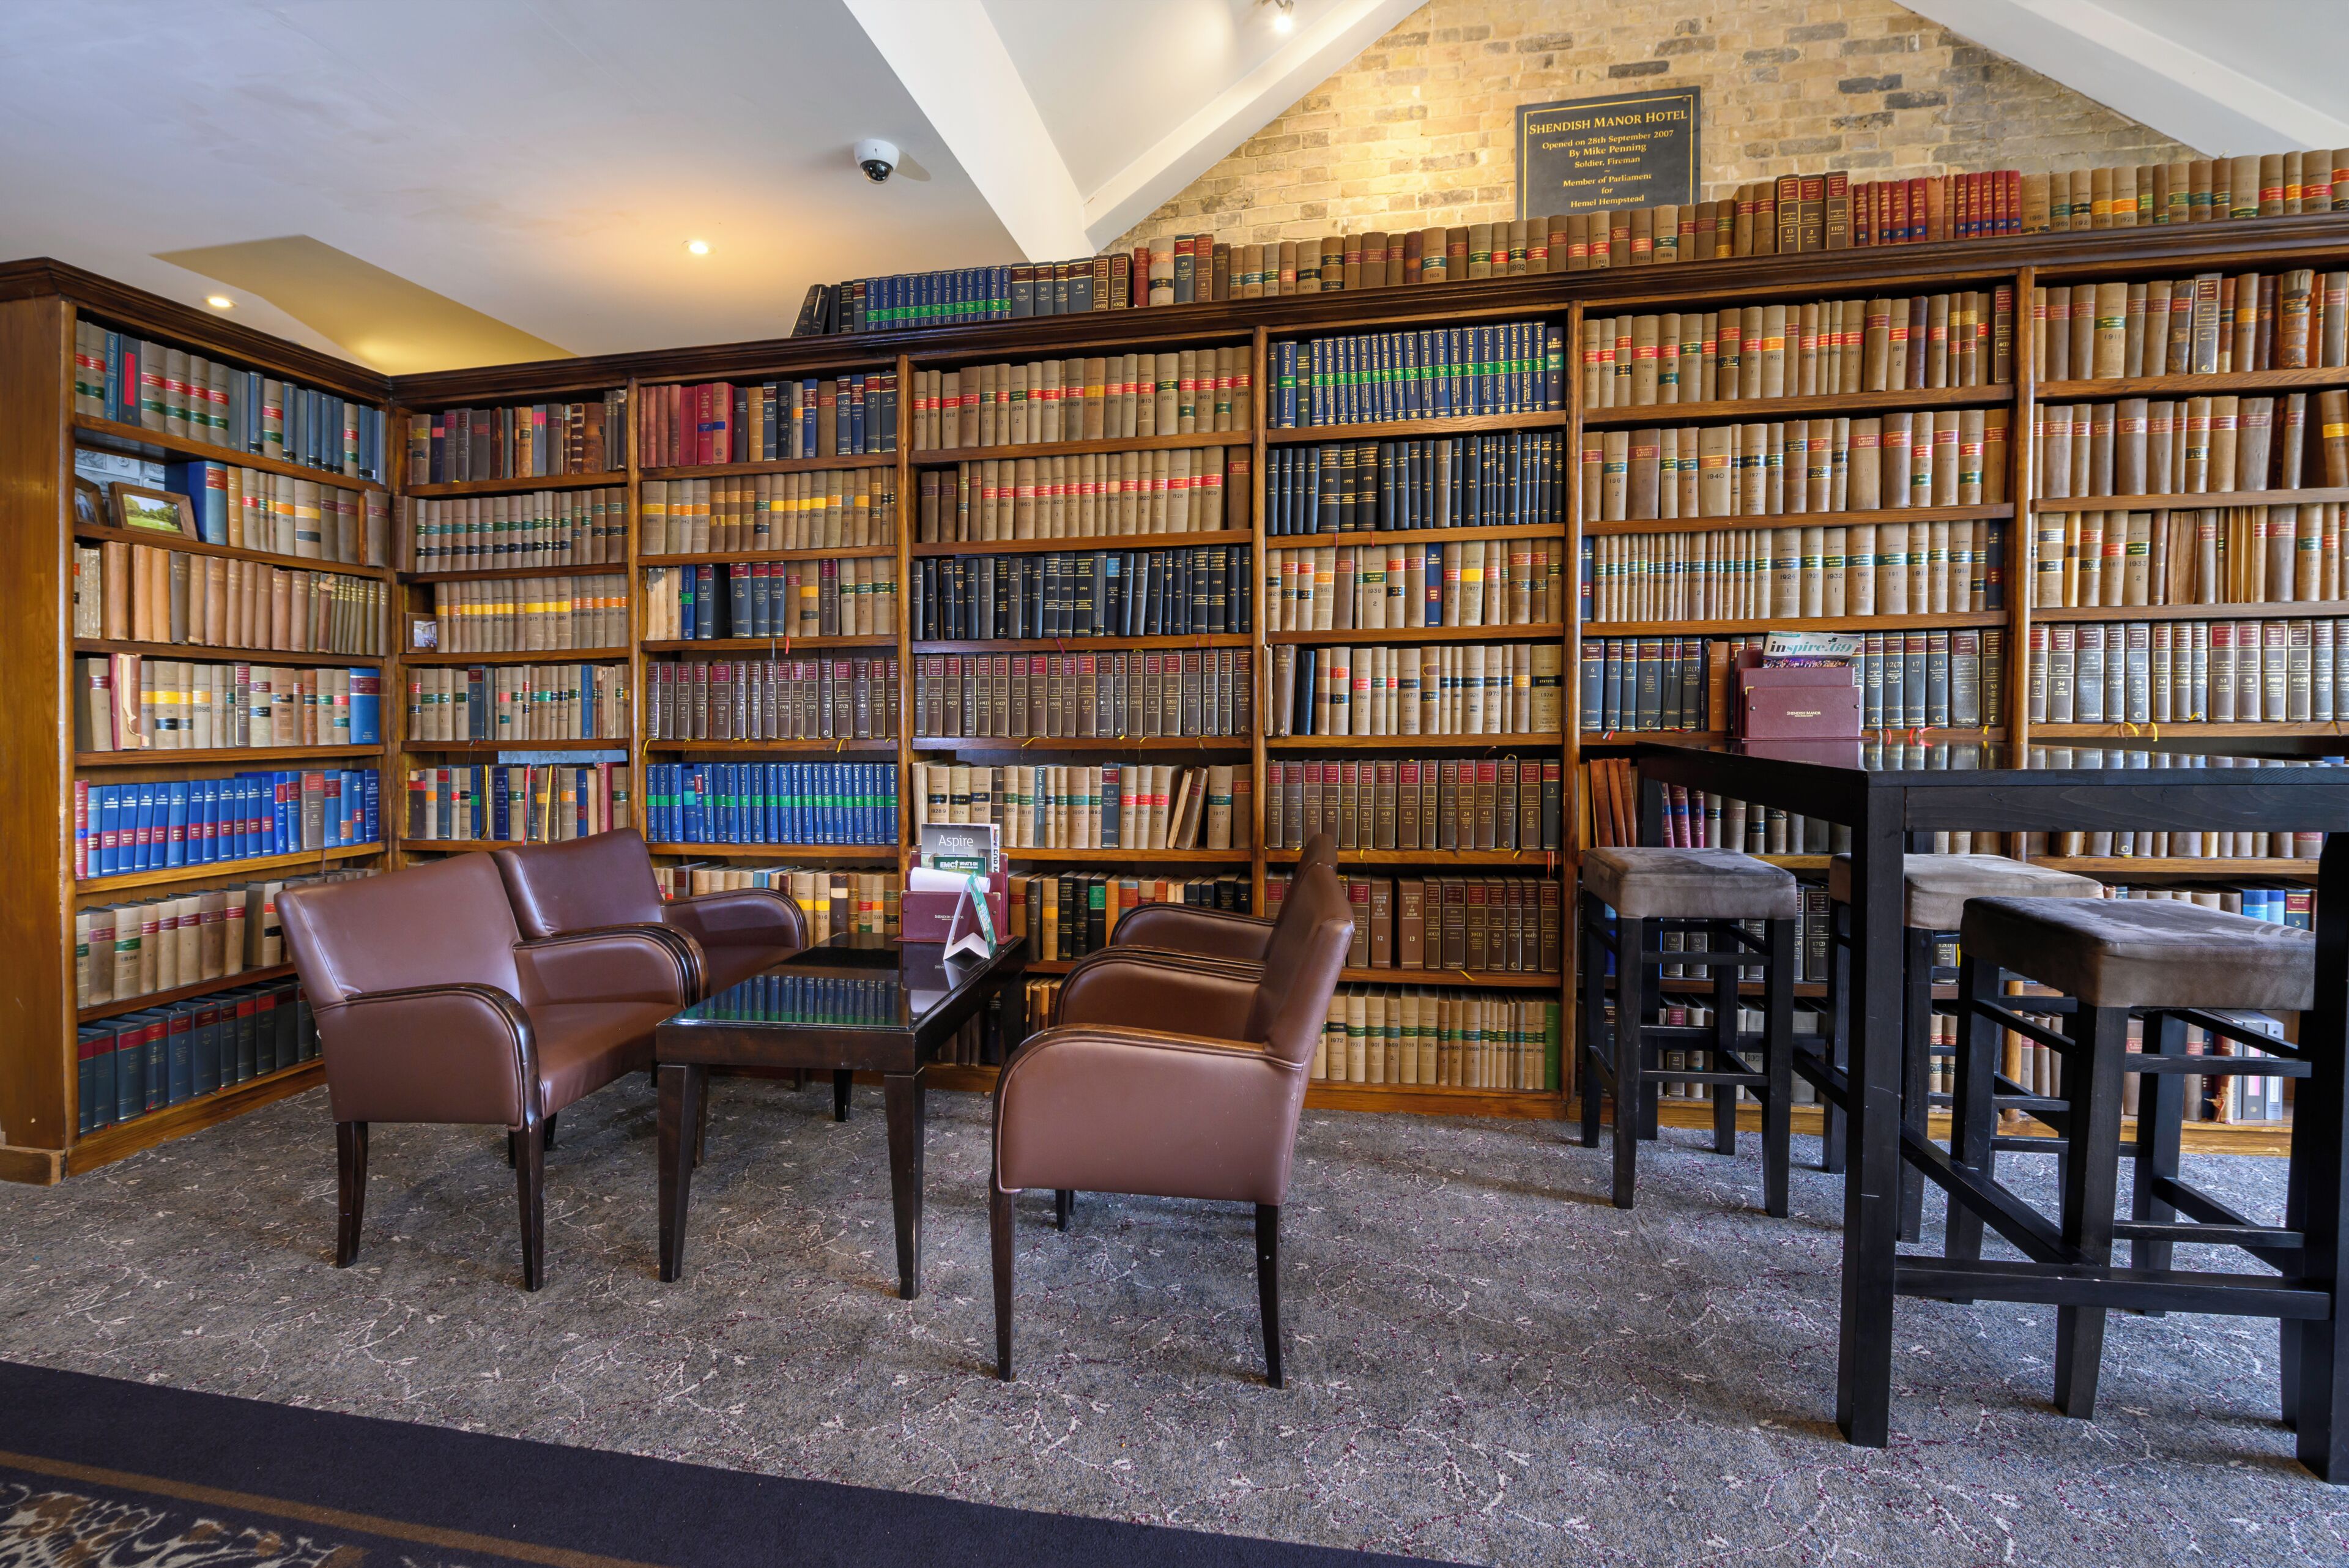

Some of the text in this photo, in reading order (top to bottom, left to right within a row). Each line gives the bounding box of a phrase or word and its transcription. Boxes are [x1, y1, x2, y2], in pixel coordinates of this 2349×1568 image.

[1529, 110, 1688, 135] SHENDISH MANOR HOTEL
[1542, 139, 1573, 150] Opened
[1608, 133, 1650, 143] September
[1653, 130, 1674, 138] 2007
[1569, 144, 1647, 158] By Mike Penning
[1575, 159, 1605, 168] Soldier,
[1563, 177, 1595, 187] Member
[1609, 173, 1652, 182] Parliament
[1571, 195, 1644, 208] Hemel Hempstead
[938, 835, 974, 852] Aspire
